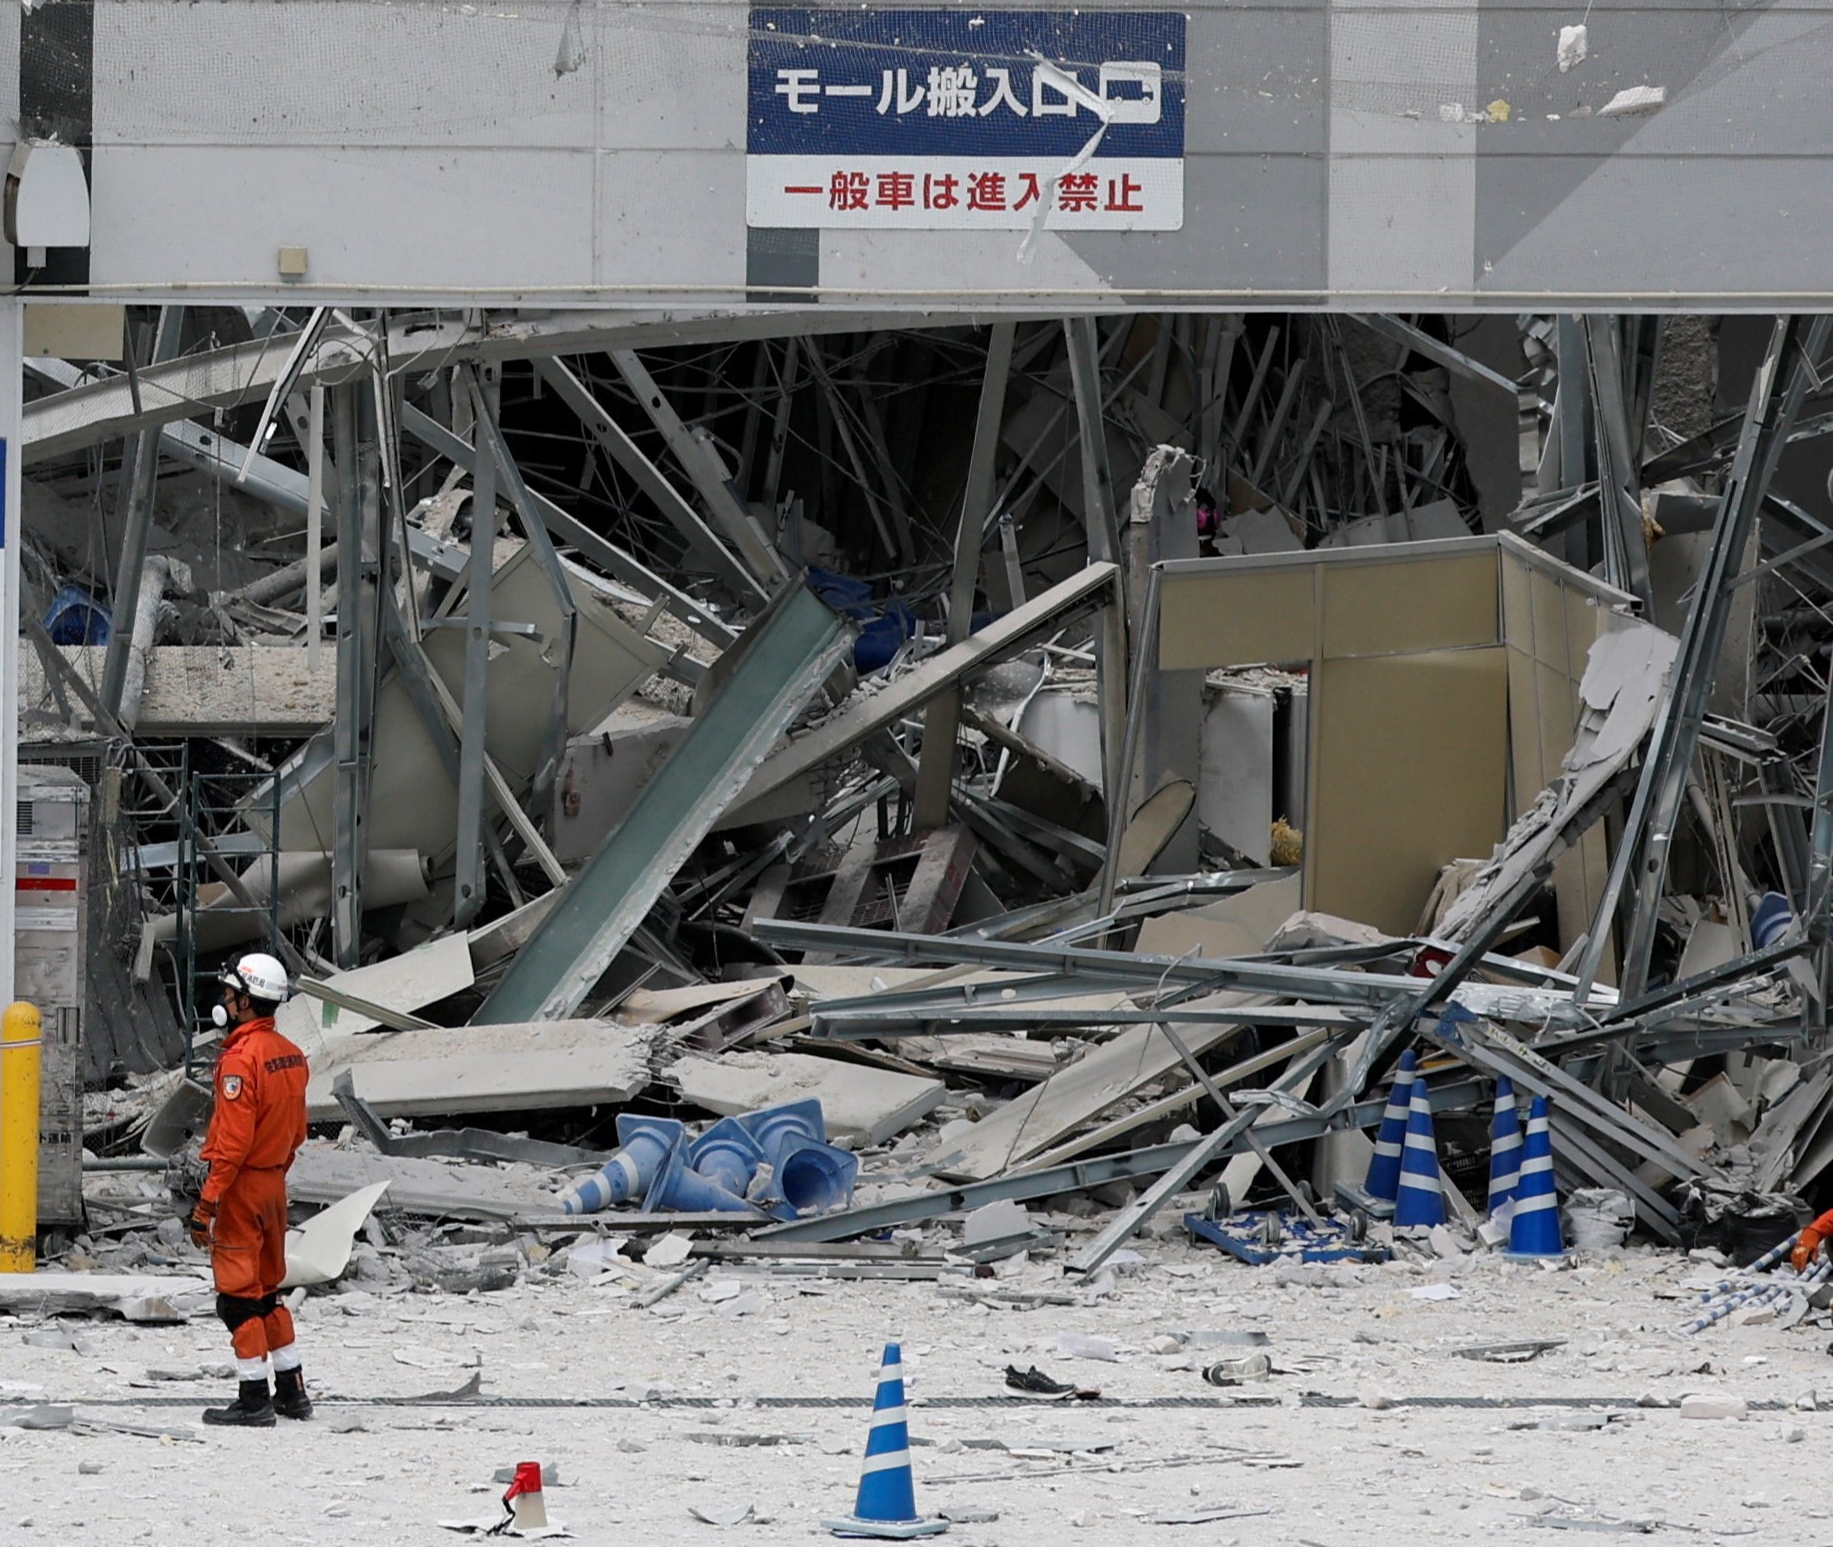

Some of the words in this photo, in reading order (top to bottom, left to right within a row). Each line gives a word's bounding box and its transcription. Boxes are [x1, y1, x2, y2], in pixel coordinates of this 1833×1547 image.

[775, 67, 1078, 119] モール搬入口
[784, 170, 1144, 213] 一般車は進入禁止
